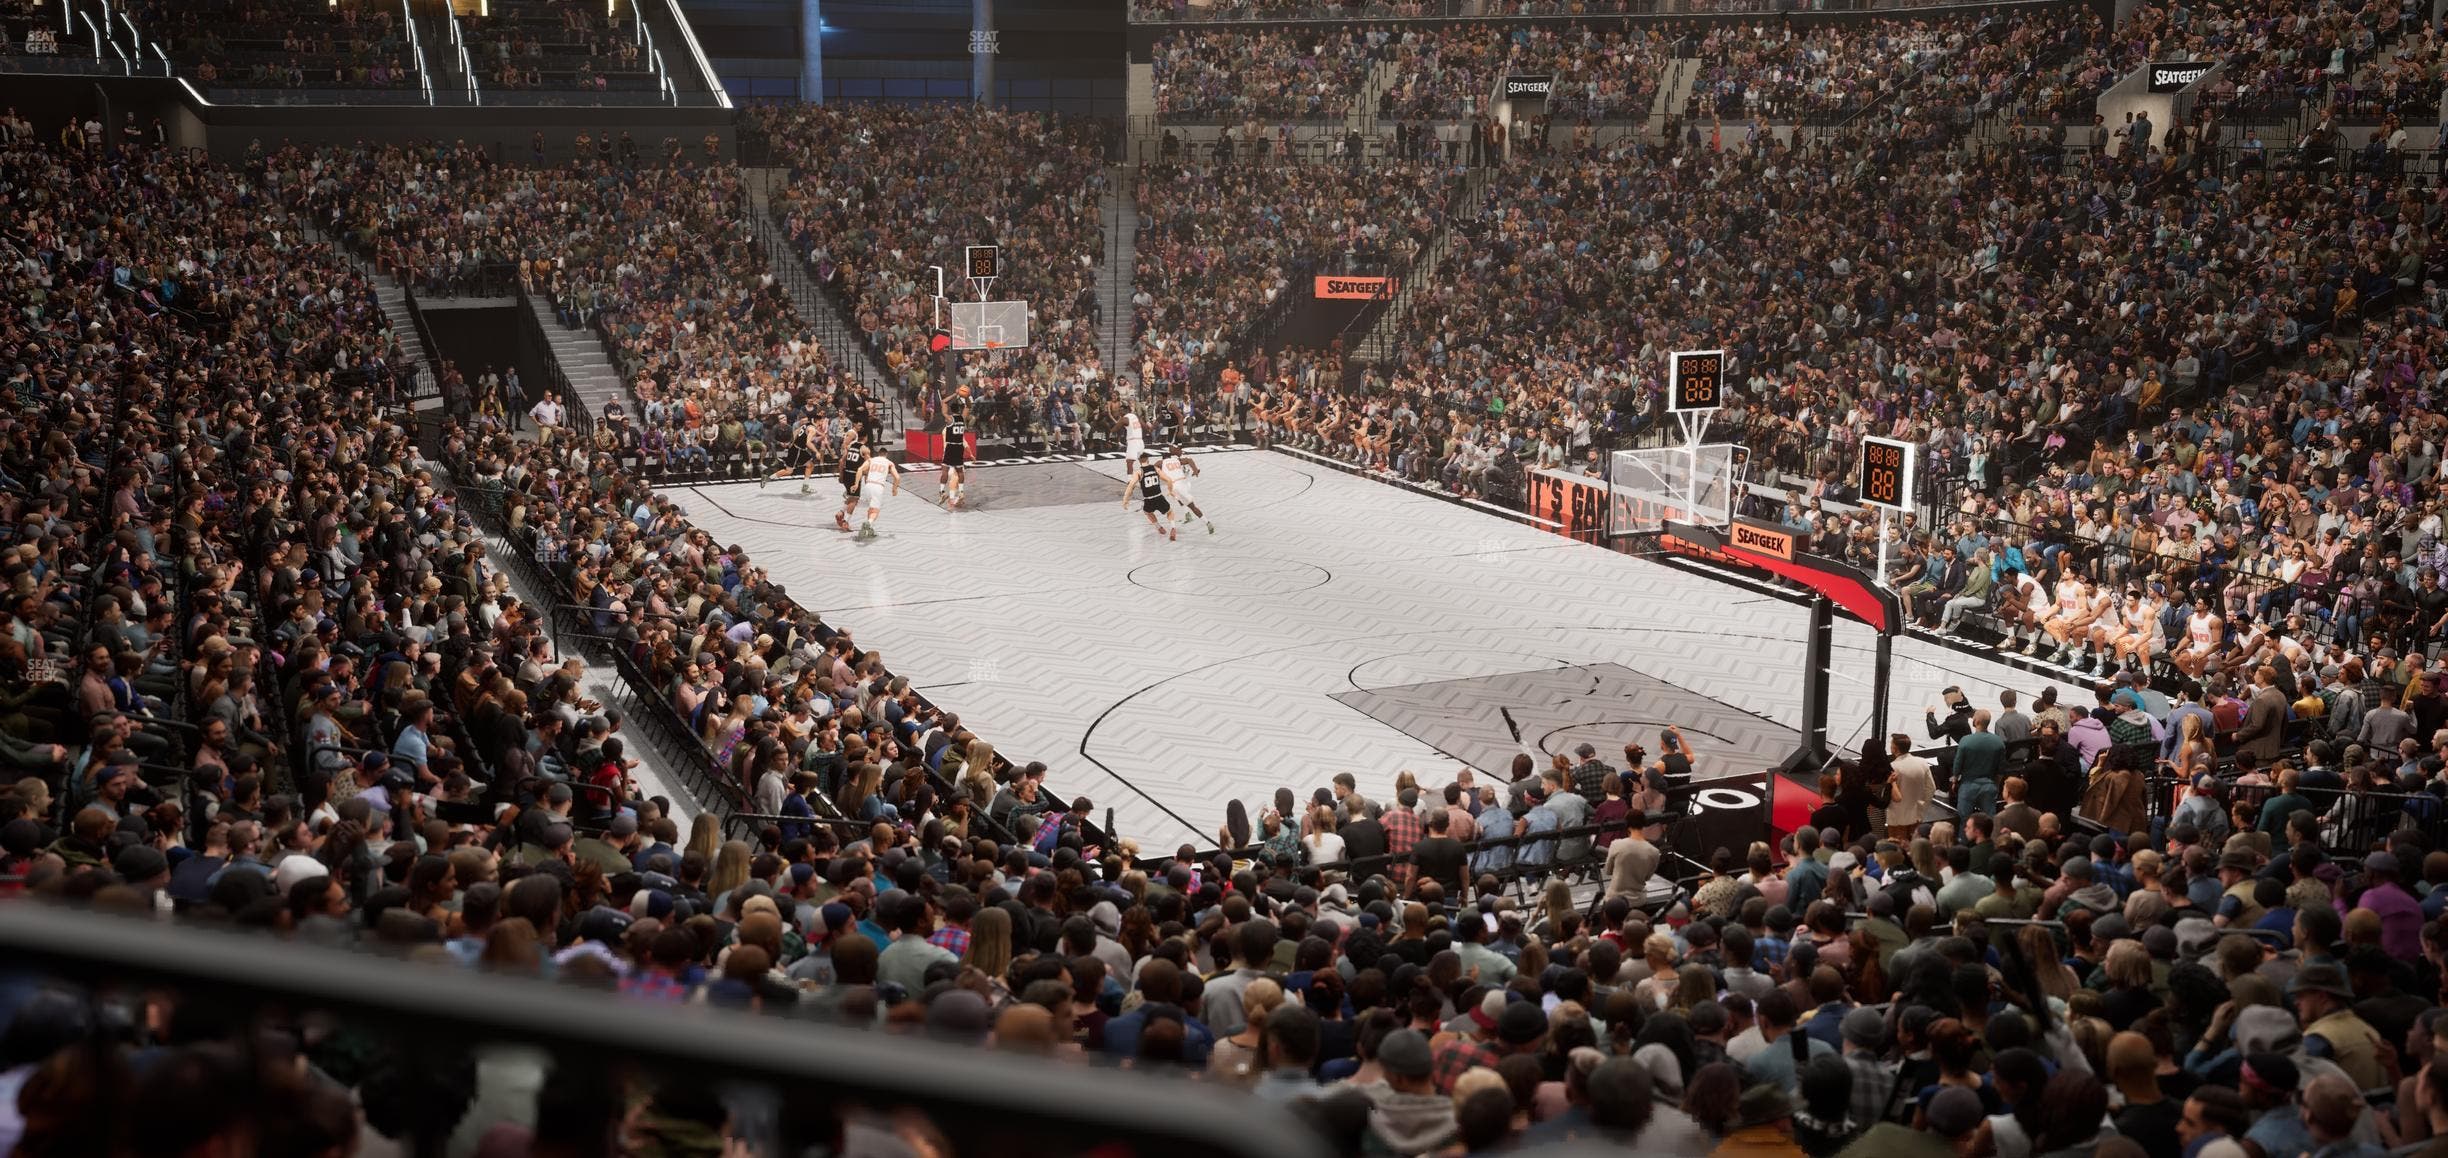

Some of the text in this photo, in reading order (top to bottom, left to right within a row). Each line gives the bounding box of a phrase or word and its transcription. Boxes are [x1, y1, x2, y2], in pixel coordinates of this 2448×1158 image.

[1508, 82, 1550, 93] SEATGEEK
[1685, 377, 1712, 402] 88
[1870, 446, 1899, 467] 88 88
[1144, 475, 1159, 488] 00
[1527, 472, 1563, 512] IT'S
[1871, 468, 1895, 500] 88
[1737, 527, 1785, 554] SEATGEEK
